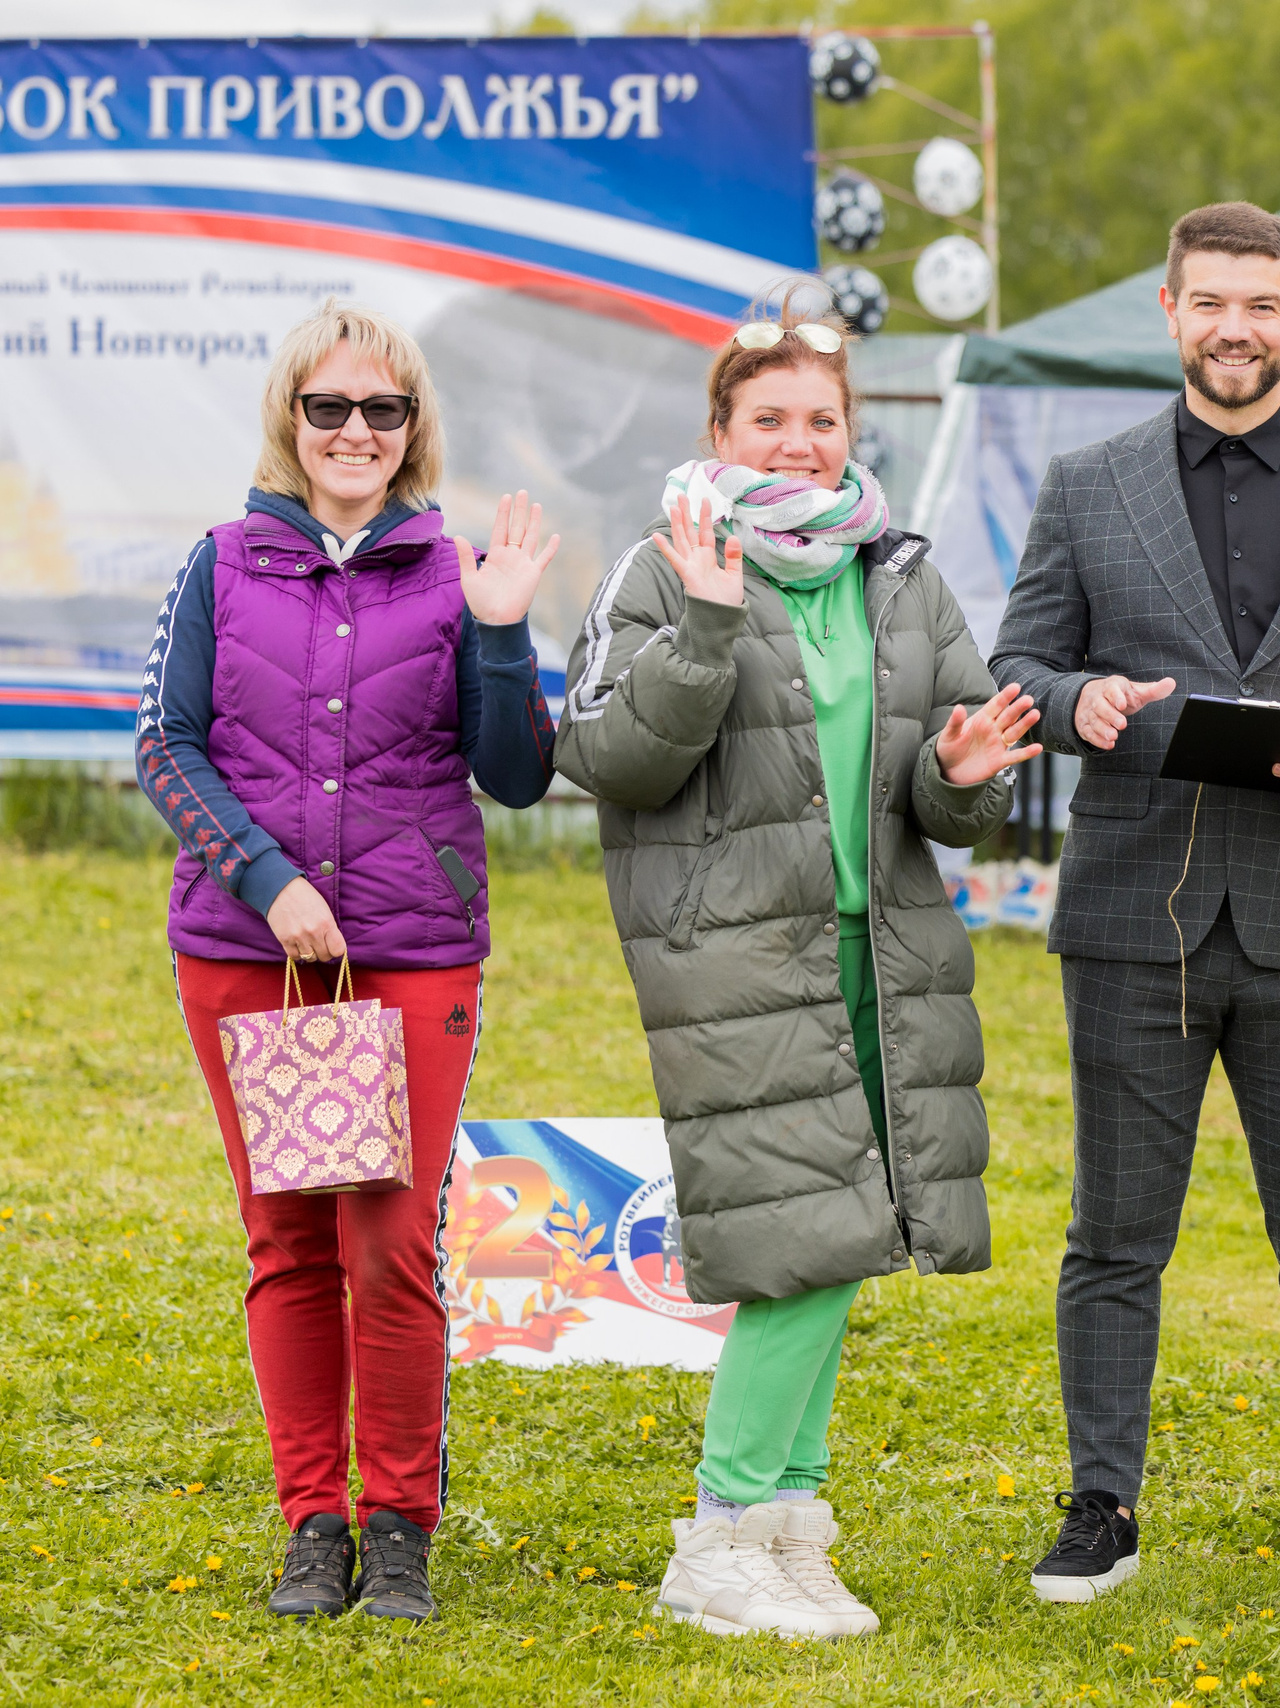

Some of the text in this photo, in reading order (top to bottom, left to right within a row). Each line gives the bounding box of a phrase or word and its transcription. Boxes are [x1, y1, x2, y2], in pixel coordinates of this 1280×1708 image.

[0, 73, 699, 141] ОК ПРИВОЛЖЬЯ”
[69, 315, 271, 369] Новгород
[444, 1023, 470, 1038] Kappa
[465, 1154, 553, 1279] 2
[627, 1274, 722, 1318] НИЖЕГОРОДС
